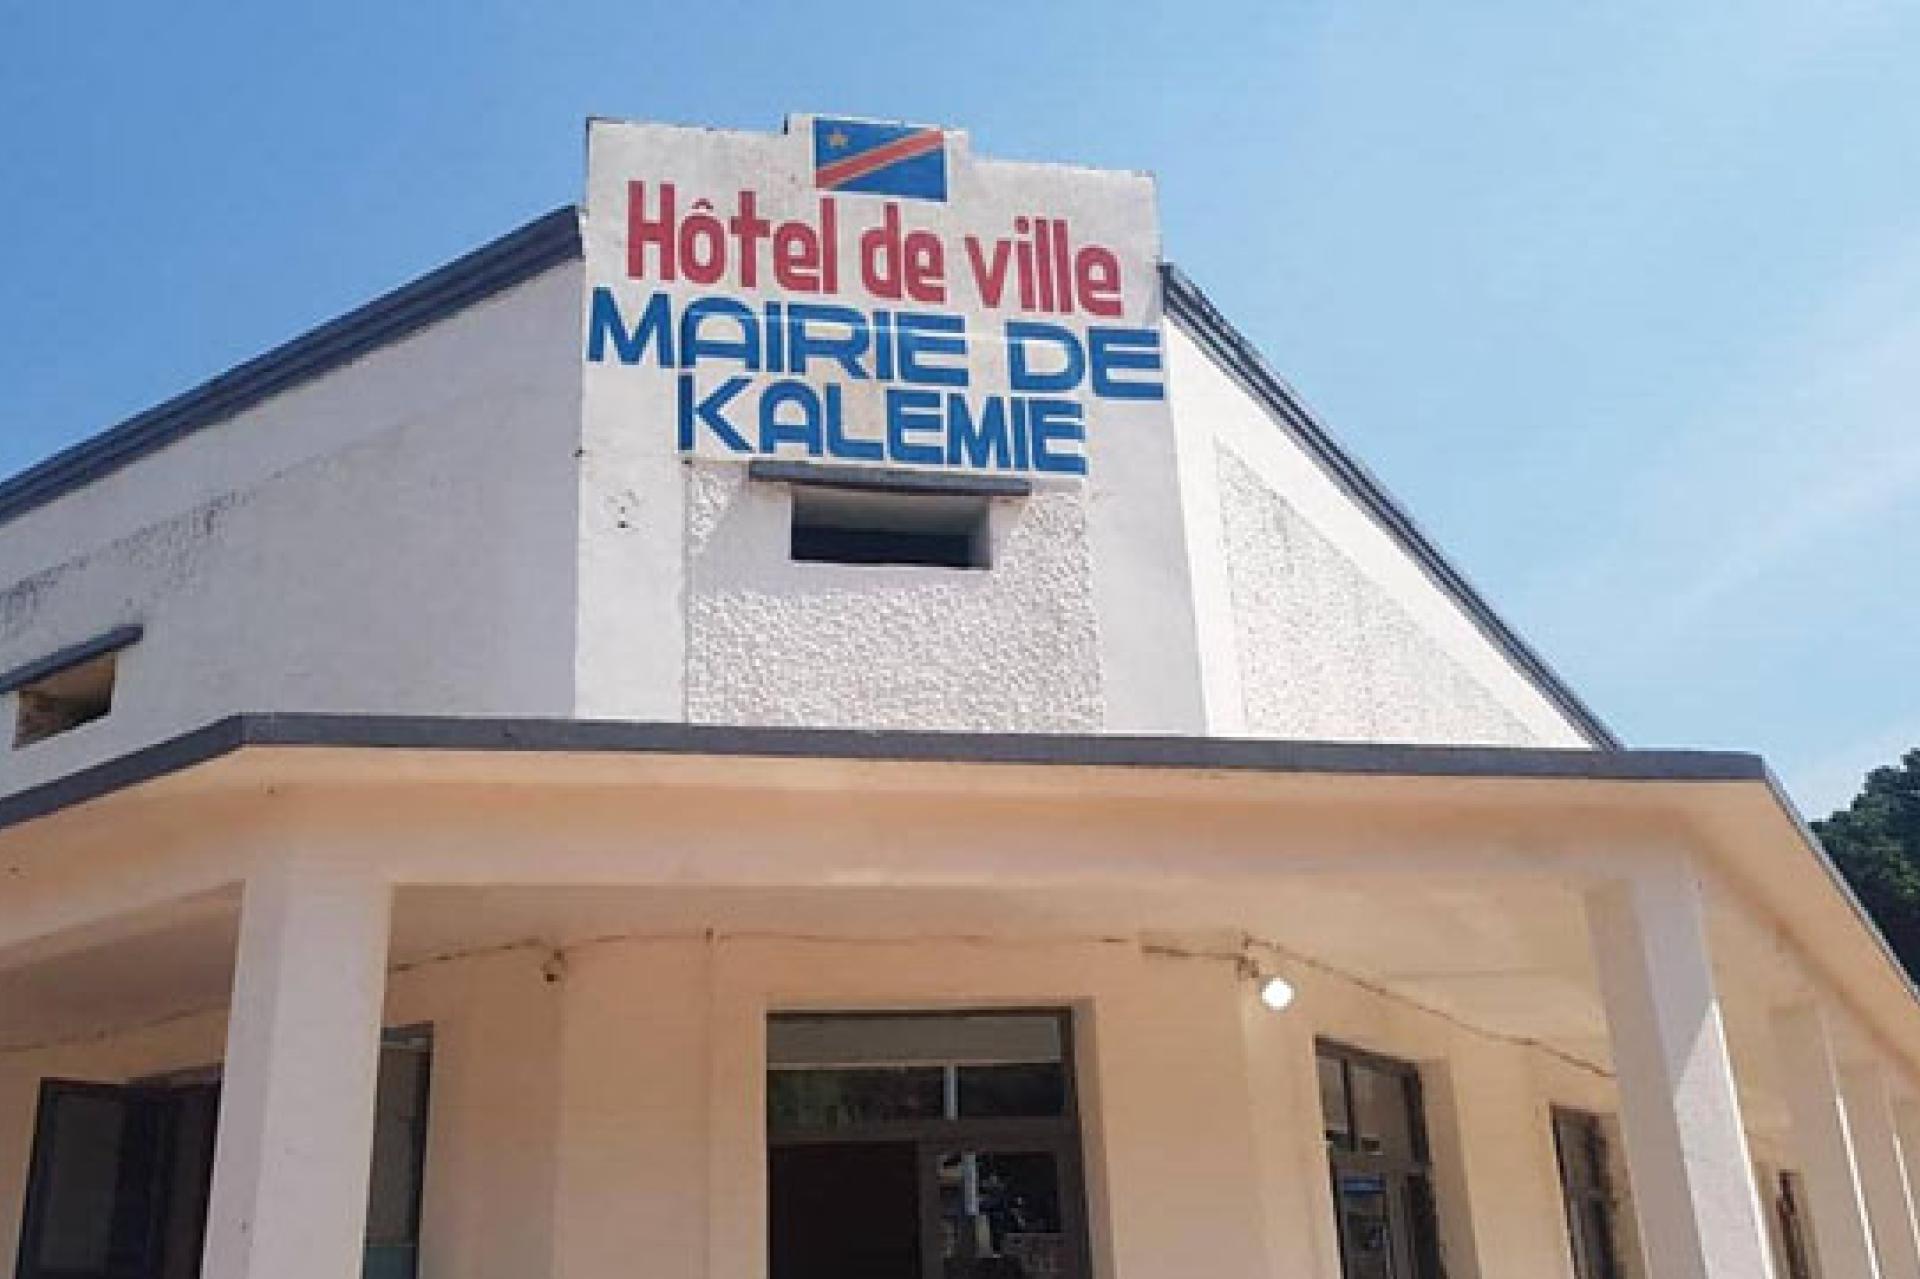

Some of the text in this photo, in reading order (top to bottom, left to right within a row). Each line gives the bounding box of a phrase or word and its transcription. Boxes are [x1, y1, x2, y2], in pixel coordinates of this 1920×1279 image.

[627, 180, 1124, 316] Hôtel de ville
[588, 287, 1164, 399] MAIRIE DE
[677, 374, 1088, 475] KALEMIE
